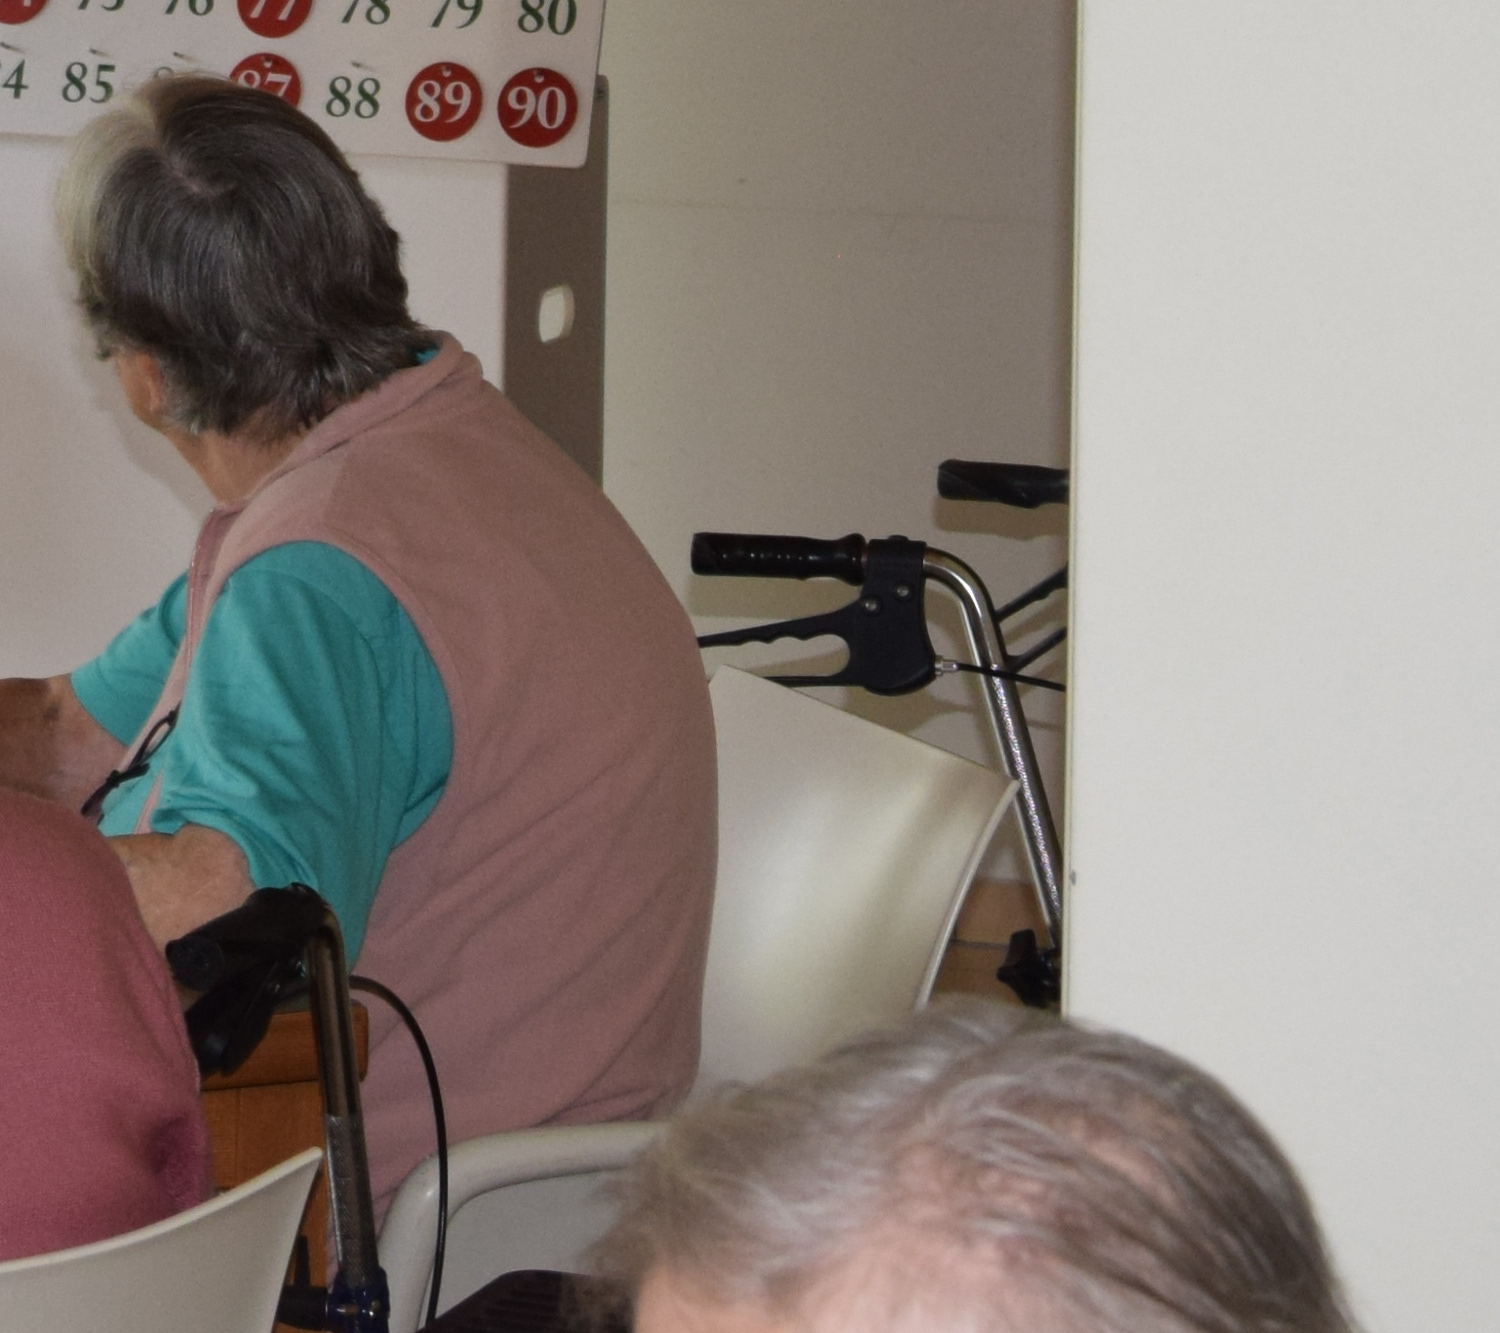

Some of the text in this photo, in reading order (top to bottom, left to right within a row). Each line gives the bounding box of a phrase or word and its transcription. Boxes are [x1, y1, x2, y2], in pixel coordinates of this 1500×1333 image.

[62, 62, 116, 104] 85
[325, 76, 381, 119] 88
[414, 80, 472, 123] 89
[507, 86, 567, 129] 90
